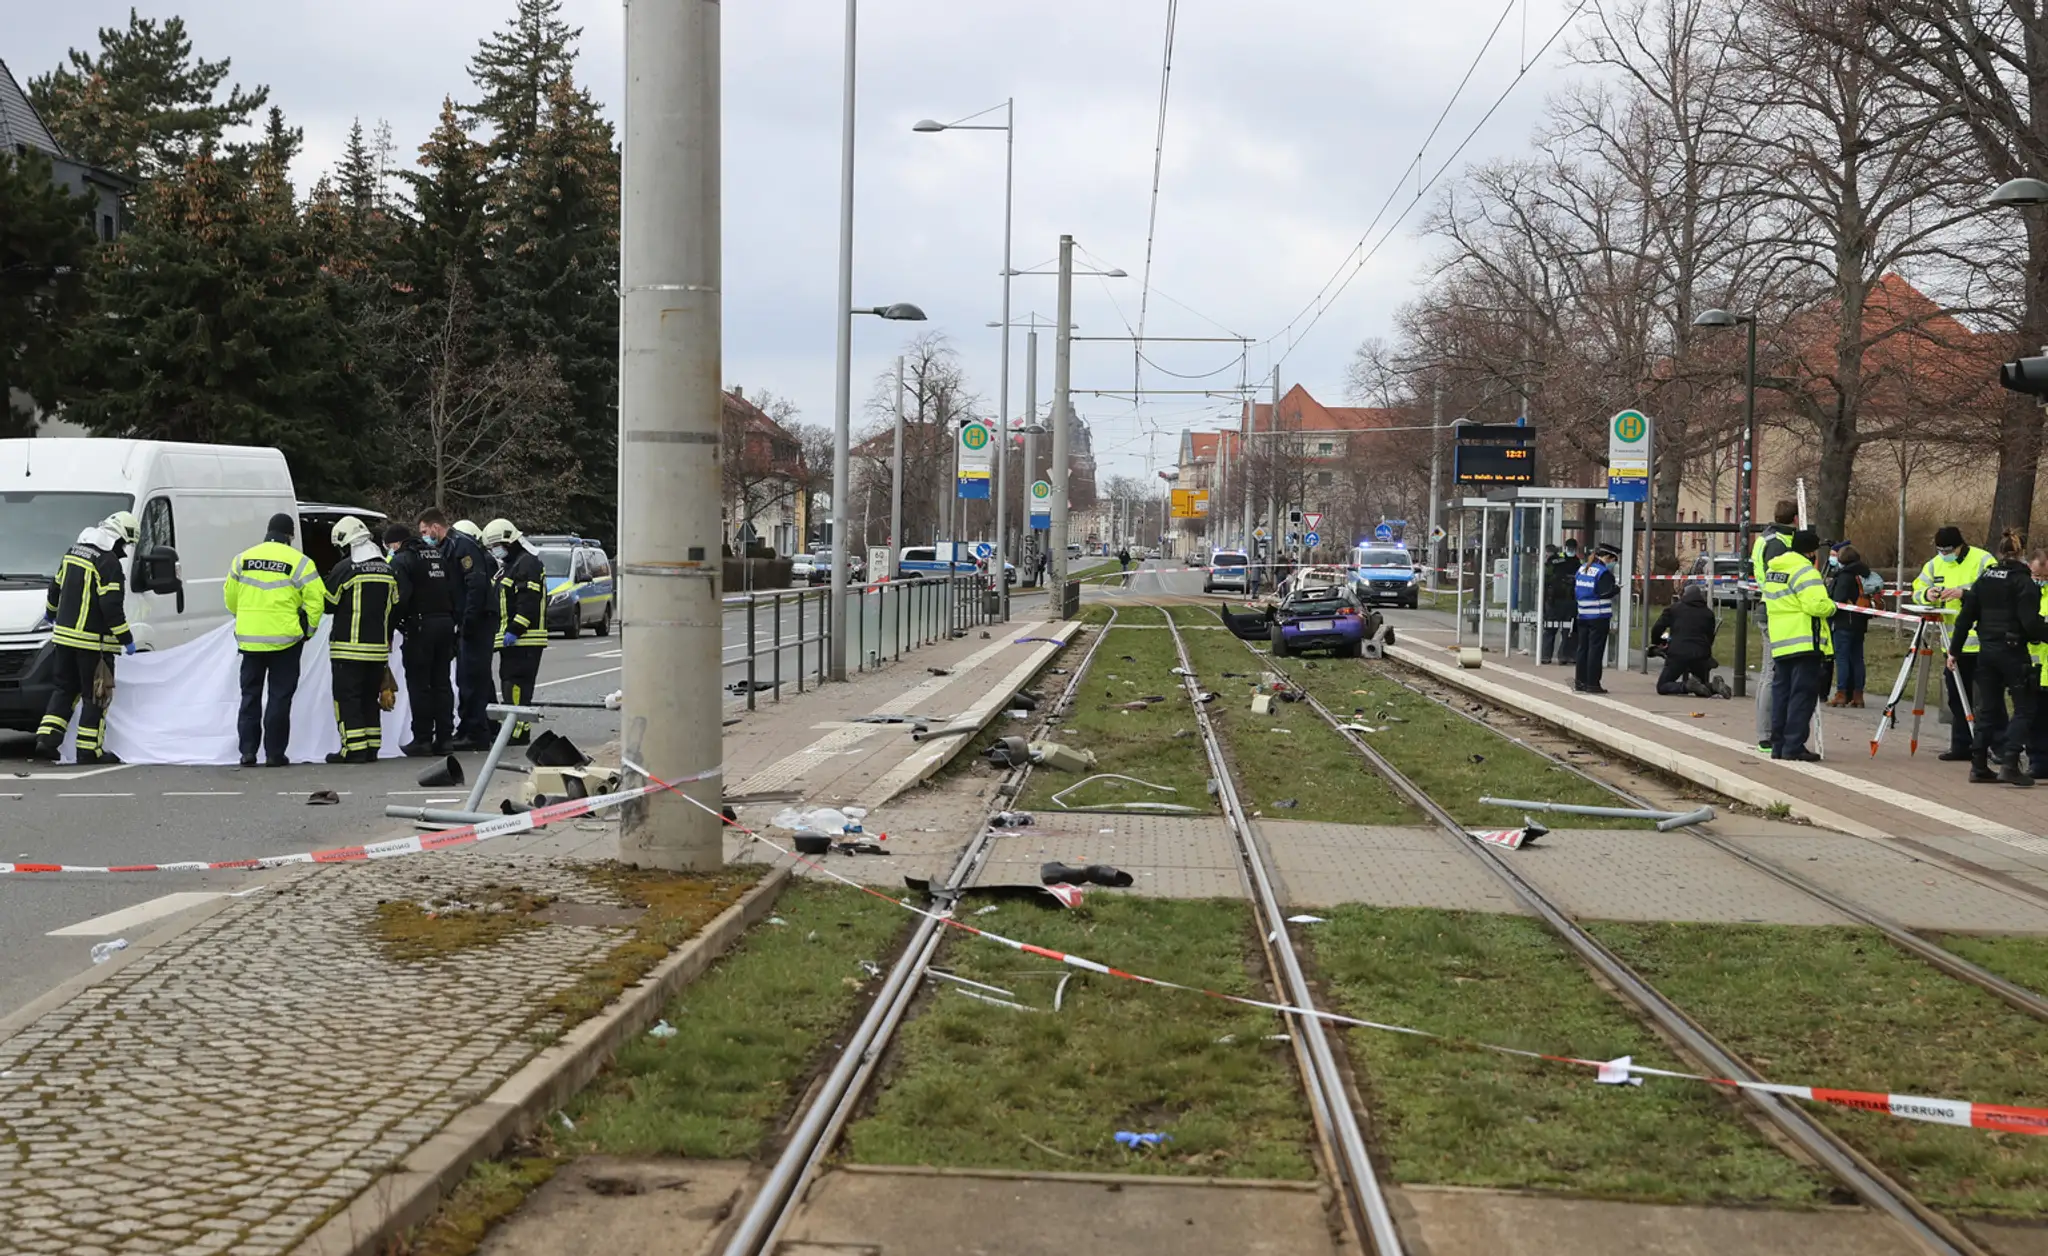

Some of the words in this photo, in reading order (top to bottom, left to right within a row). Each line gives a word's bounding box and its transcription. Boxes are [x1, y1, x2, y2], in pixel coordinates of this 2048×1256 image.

[1623, 419, 1637, 436] H
[970, 430, 980, 445] H
[247, 560, 287, 572] POLIZEI
[1825, 1096, 1955, 1118] POLIZEIABSPERRUNG
